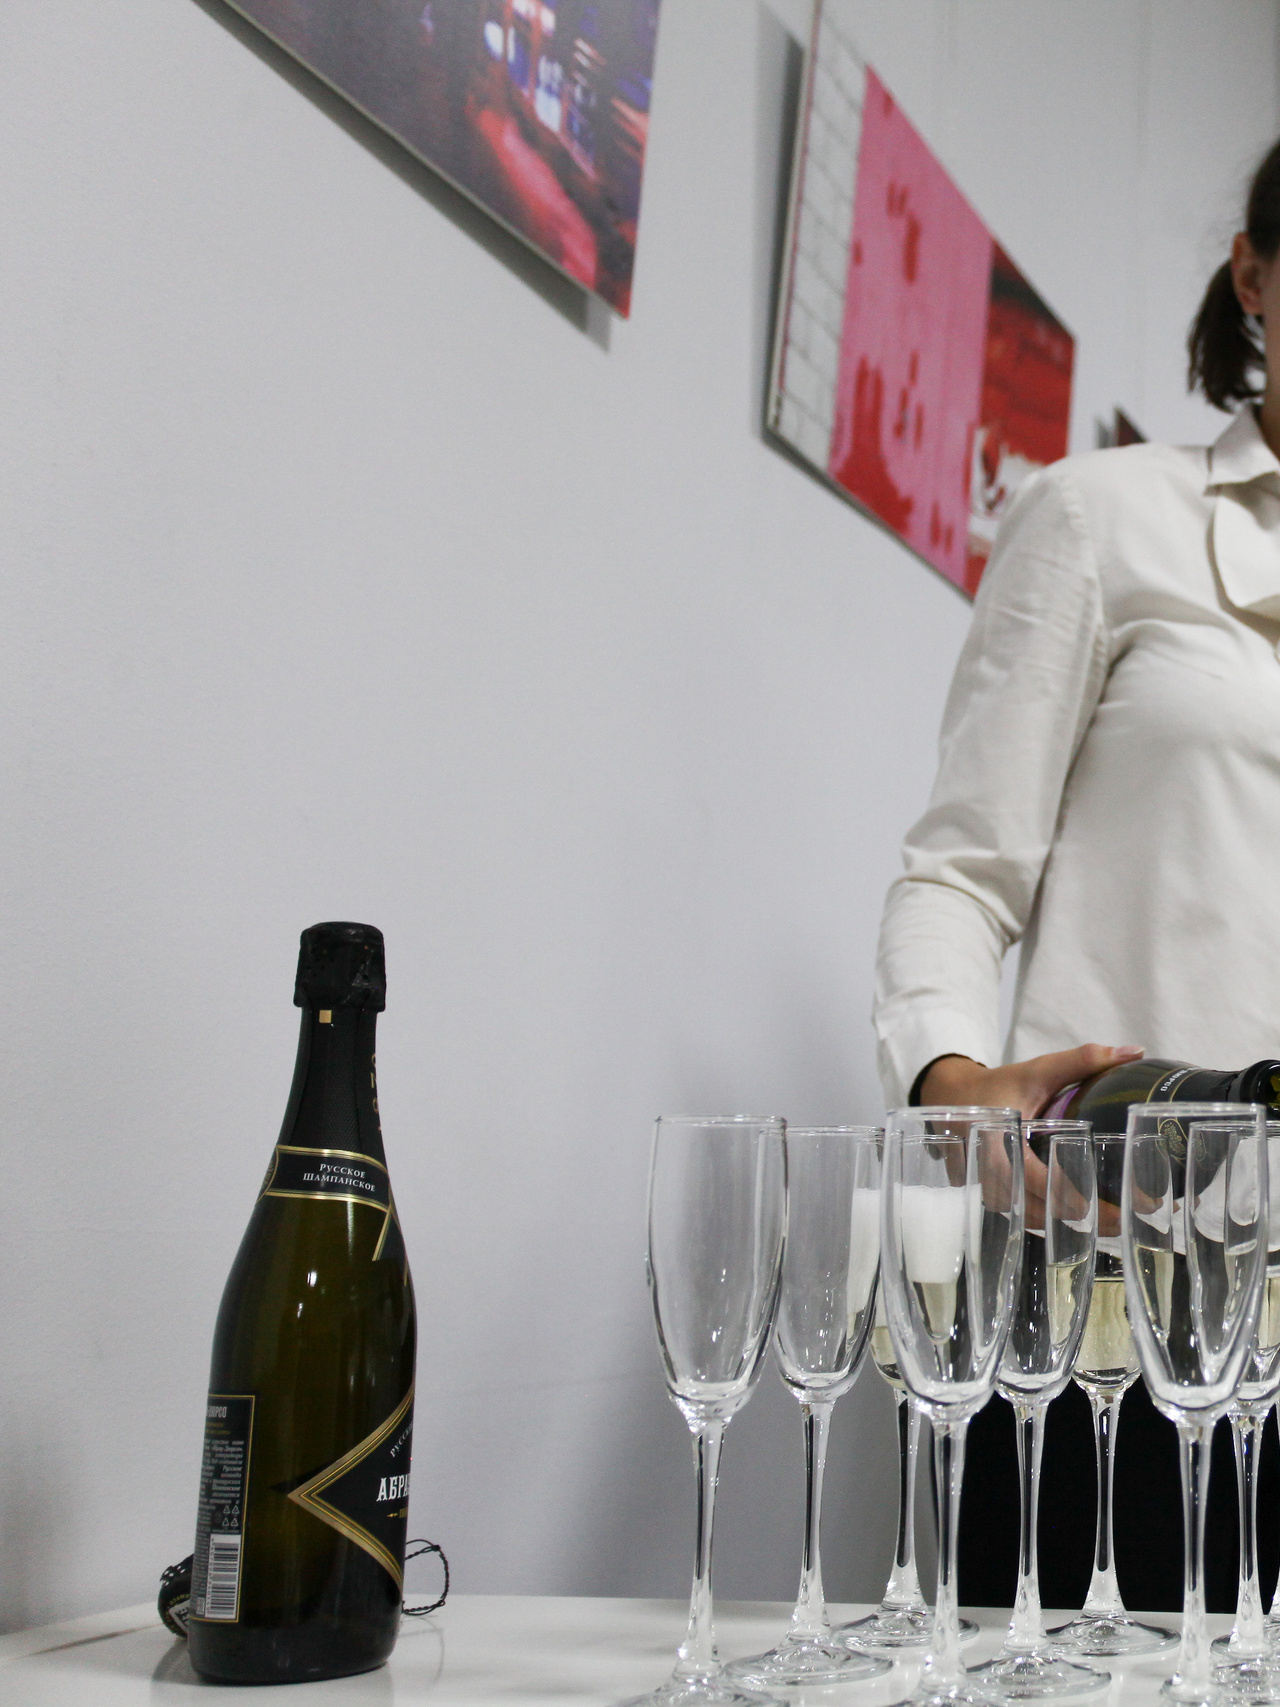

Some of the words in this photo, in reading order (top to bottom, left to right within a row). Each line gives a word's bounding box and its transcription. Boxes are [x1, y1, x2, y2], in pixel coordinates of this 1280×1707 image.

[319, 1163, 366, 1179] РУССКОЕ
[303, 1173, 376, 1192] ШАМПАНСКОЕ
[376, 1473, 410, 1502] АБРА
